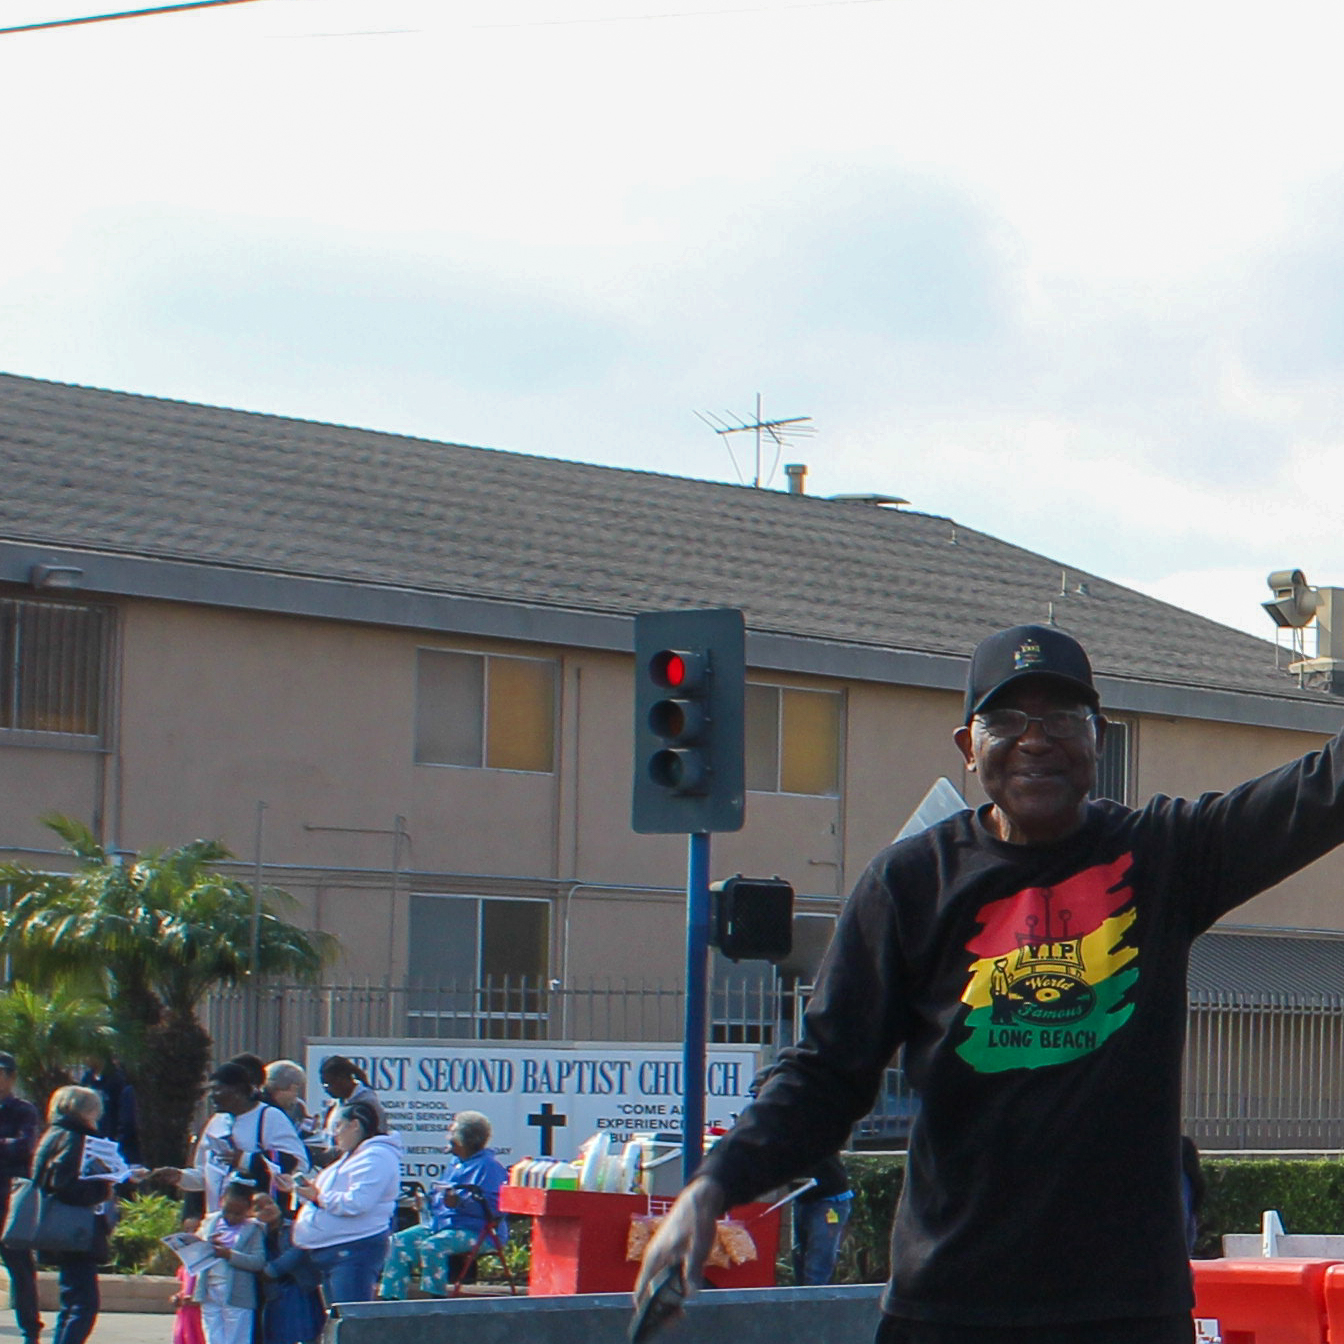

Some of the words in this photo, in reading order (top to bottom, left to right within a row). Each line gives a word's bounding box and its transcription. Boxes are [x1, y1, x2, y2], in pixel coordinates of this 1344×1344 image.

[1025, 977, 1075, 991] World
[1018, 1001, 1083, 1019] Famous
[988, 1028, 1033, 1049] LONG
[1040, 1029, 1097, 1049] BEACH
[418, 1056, 514, 1093] SECOND
[521, 1058, 632, 1095] BAPTIST
[638, 1061, 742, 1098] CHUCH
[408, 1100, 449, 1110] SCHOOL
